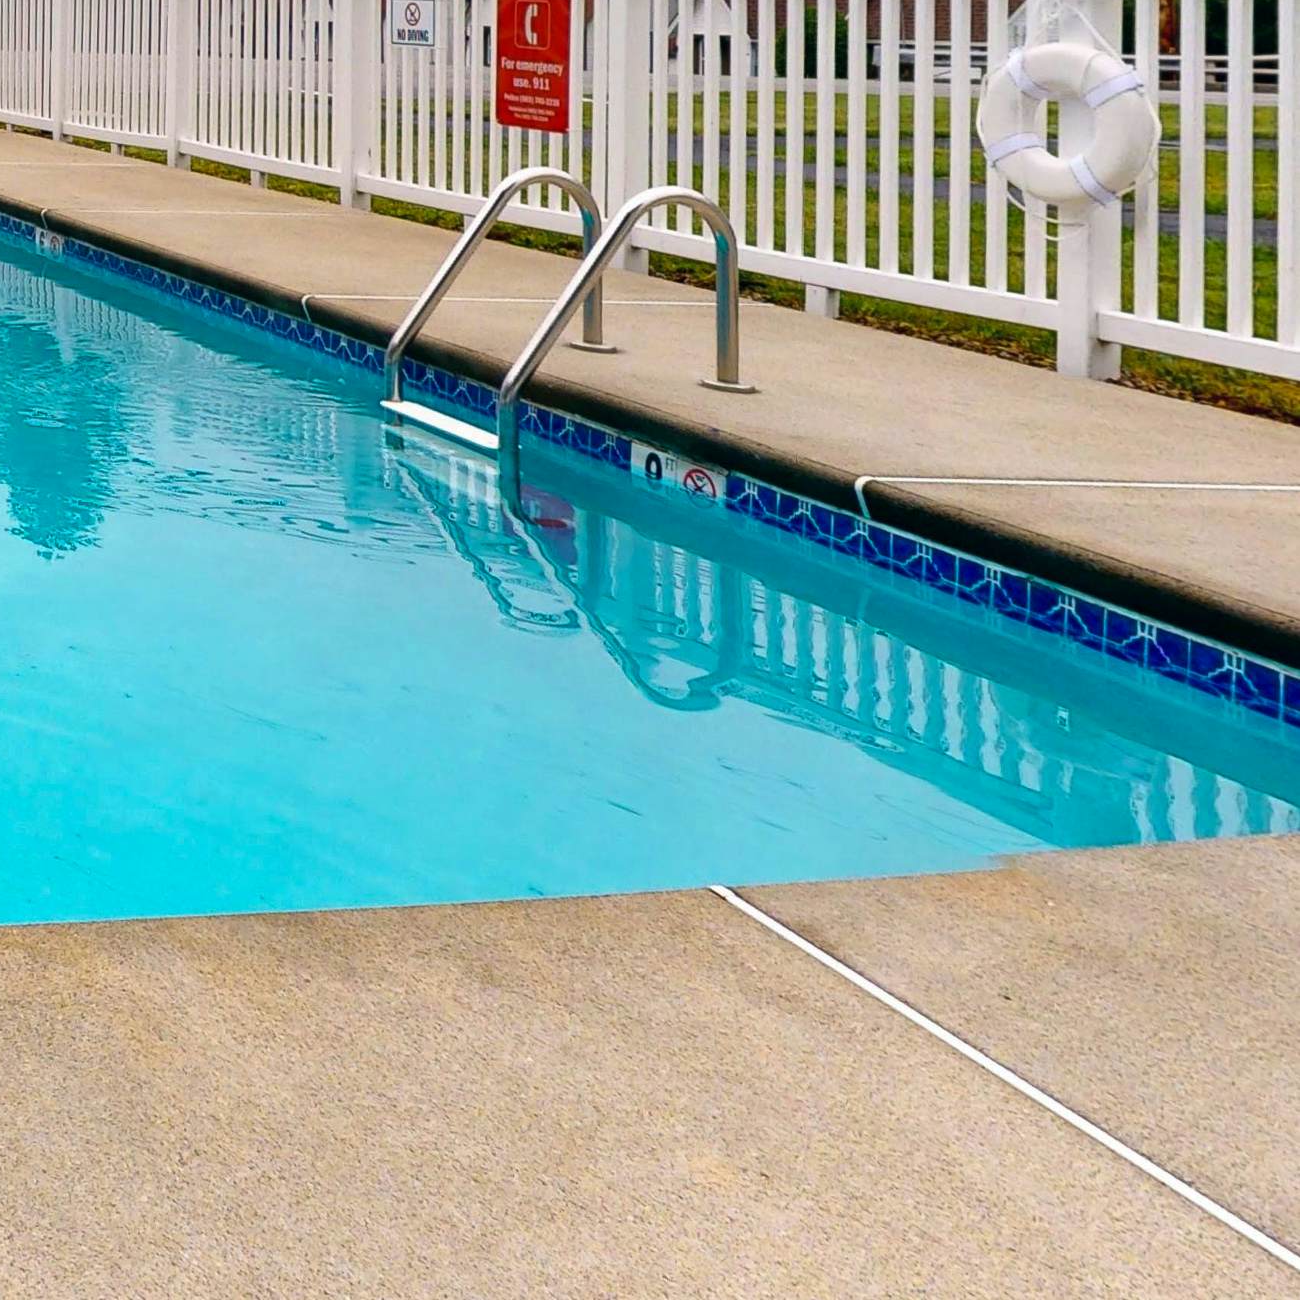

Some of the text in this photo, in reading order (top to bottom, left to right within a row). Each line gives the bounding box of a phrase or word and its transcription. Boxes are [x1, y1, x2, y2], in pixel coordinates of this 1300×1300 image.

[397, 28, 429, 42] NO DIVING
[501, 56, 564, 76] For emergency
[532, 76, 550, 91] 911
